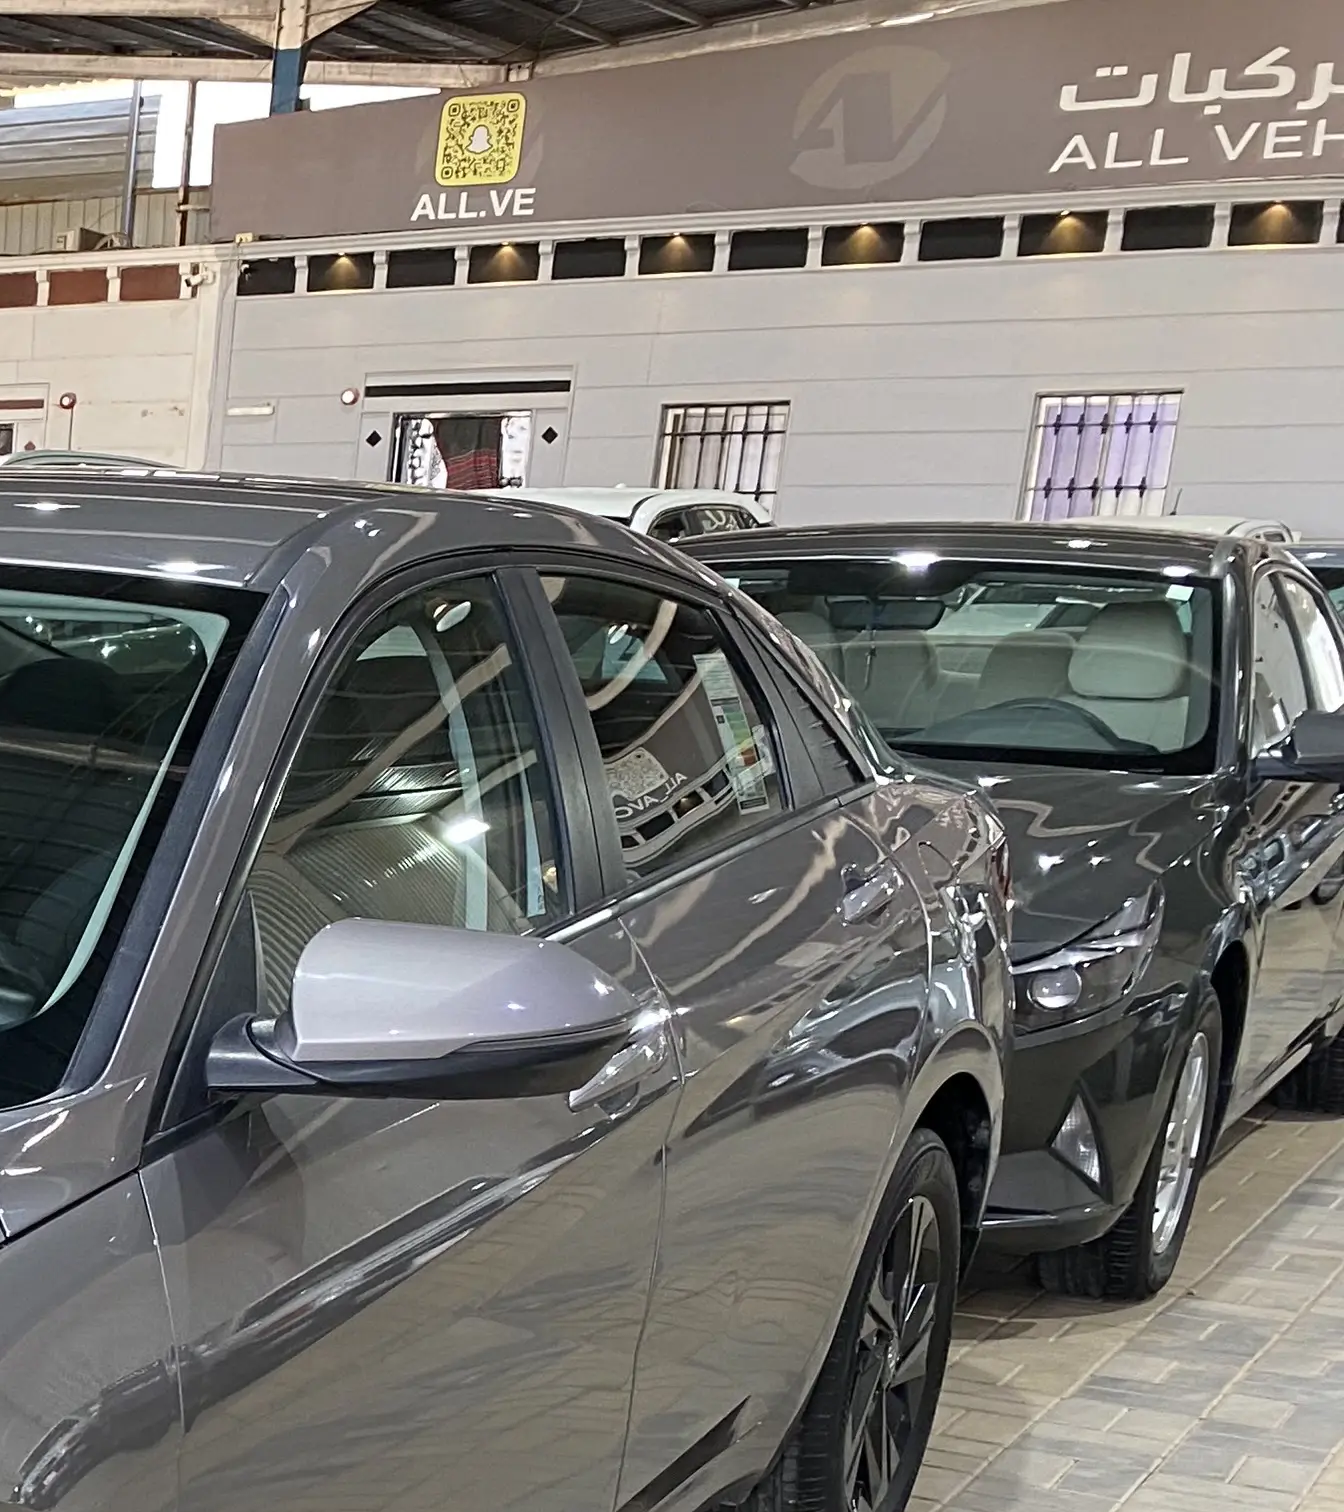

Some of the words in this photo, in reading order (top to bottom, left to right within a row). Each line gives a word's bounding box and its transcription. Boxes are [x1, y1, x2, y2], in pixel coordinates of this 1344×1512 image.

[1059, 46, 1344, 115] ركبات
[1048, 128, 1189, 173] ALL
[1214, 119, 1344, 161] VEH
[410, 187, 537, 222] ALL.VE
